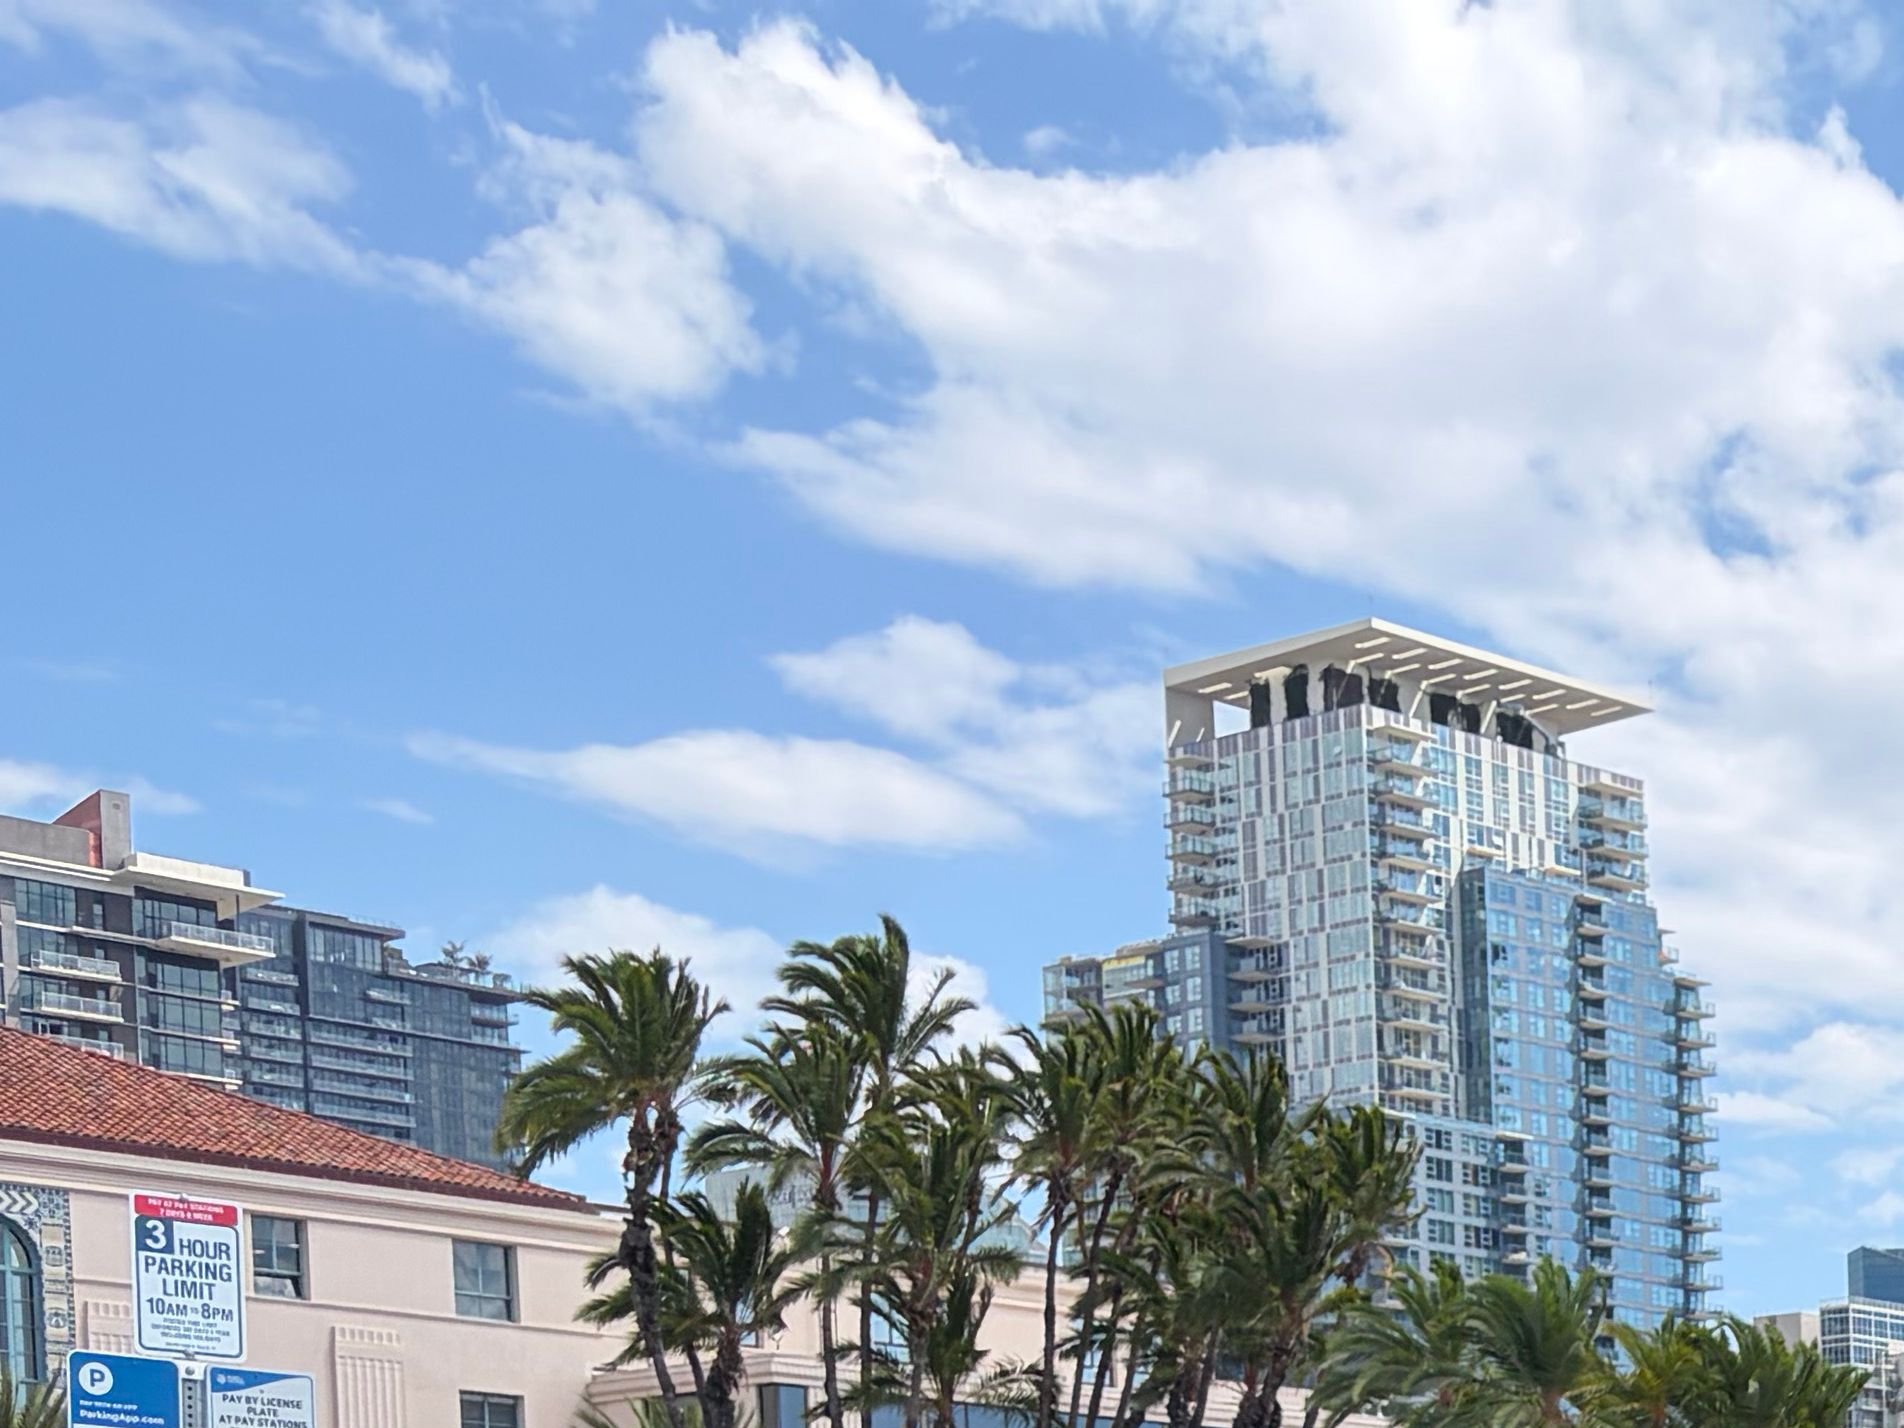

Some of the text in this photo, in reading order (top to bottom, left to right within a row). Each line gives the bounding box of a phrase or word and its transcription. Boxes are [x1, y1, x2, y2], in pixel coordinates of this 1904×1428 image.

[144, 1220, 166, 1249] 3
[179, 1238, 230, 1260] HOUR
[144, 1255, 232, 1282] PARKING
[162, 1278, 216, 1300] LIMIT
[146, 1297, 188, 1317] 10AM
[201, 1302, 233, 1322] 8PM
[90, 1368, 105, 1388] P
[222, 1394, 302, 1410] PAY BY LICENSE
[246, 1406, 279, 1418] PLATE
[218, 1414, 232, 1424] AT
[234, 1416, 256, 1426] PAY
